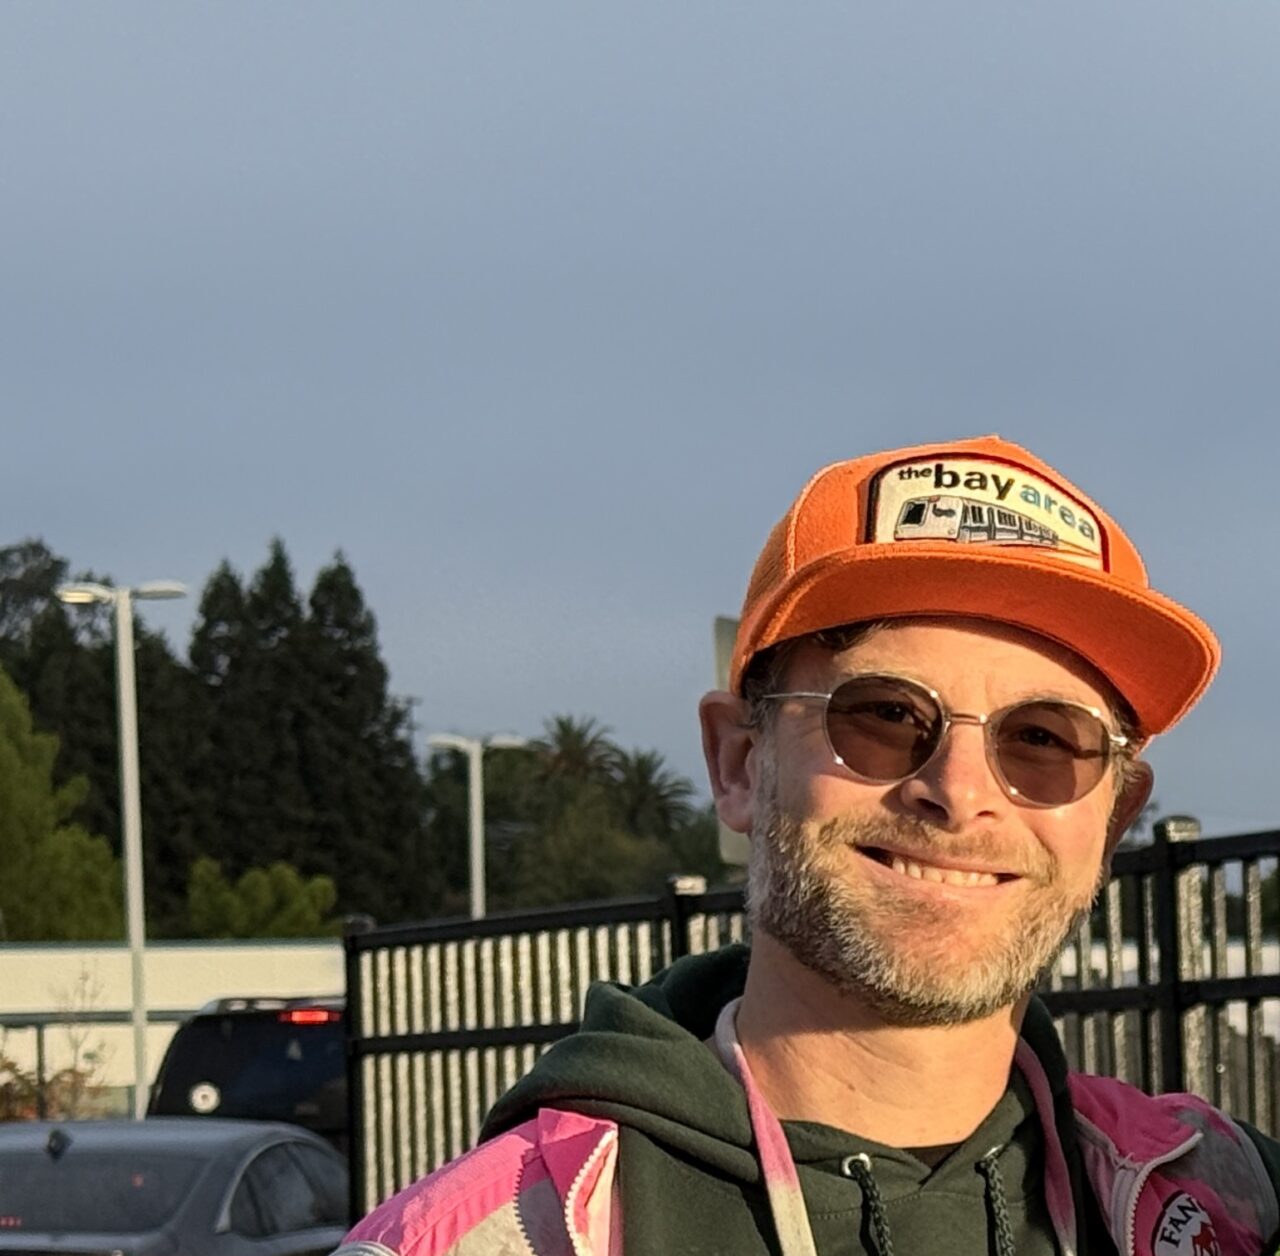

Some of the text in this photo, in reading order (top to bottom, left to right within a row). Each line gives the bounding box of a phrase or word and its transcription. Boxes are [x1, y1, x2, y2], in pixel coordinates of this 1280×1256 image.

[898, 463, 1096, 542] the bay area
